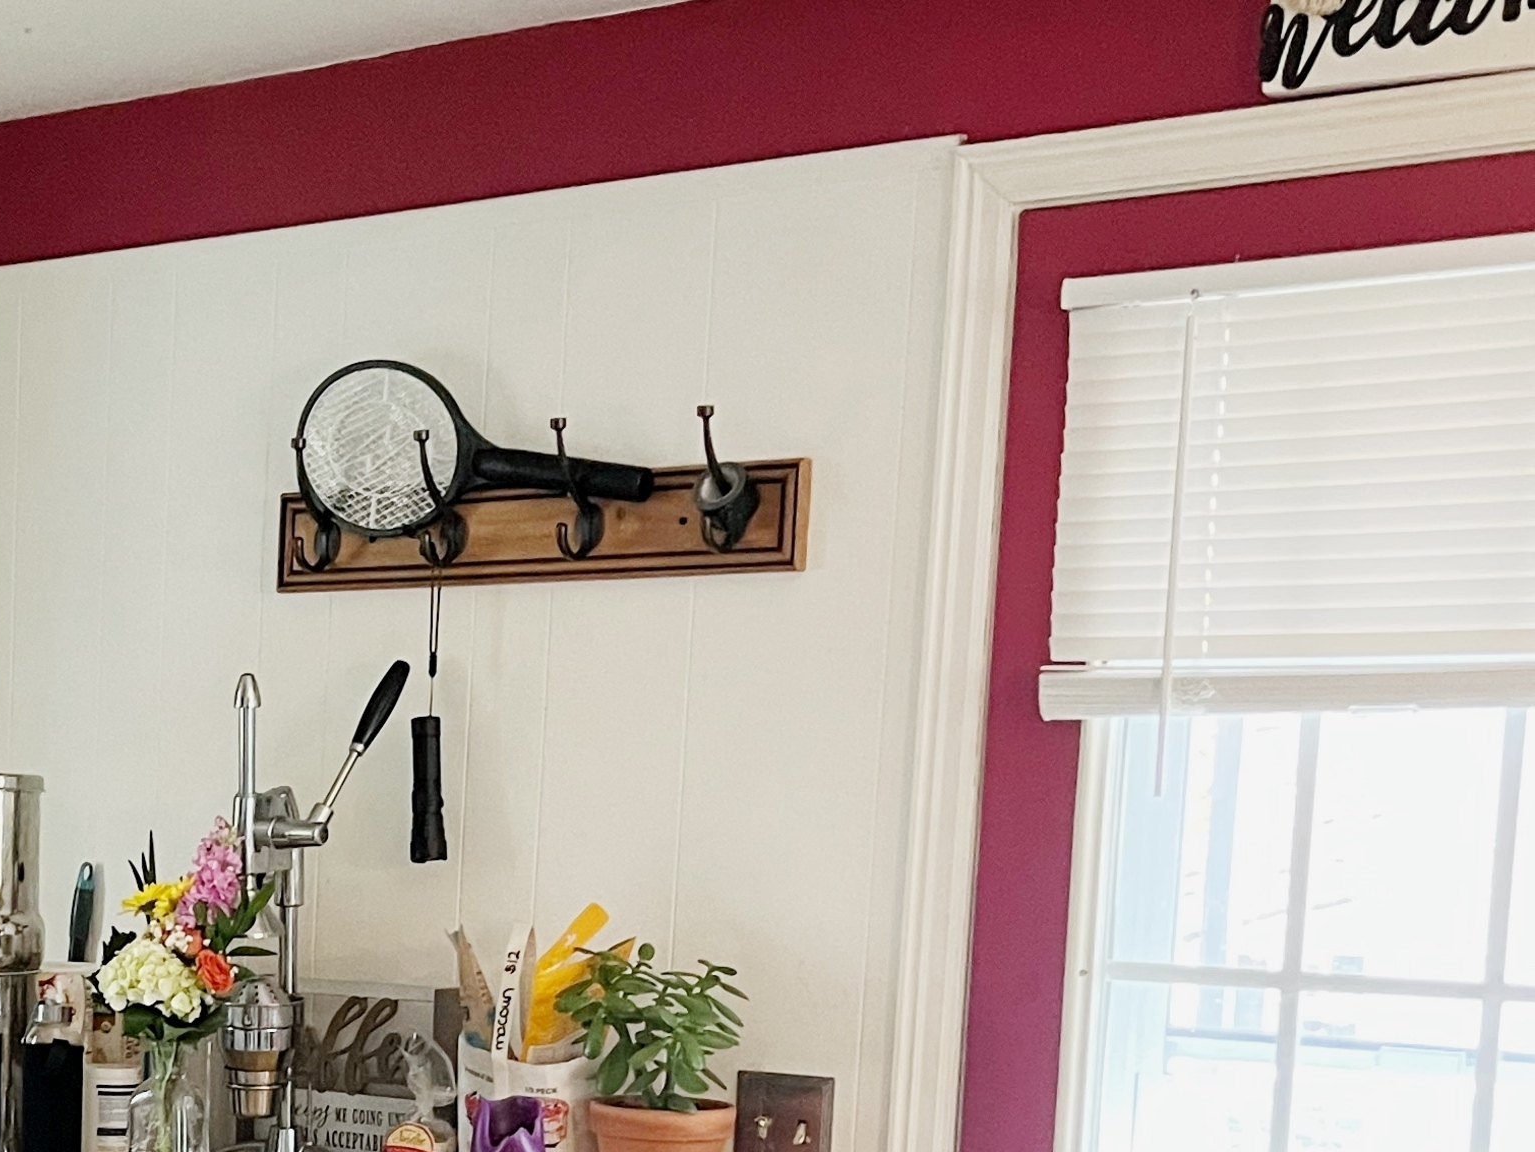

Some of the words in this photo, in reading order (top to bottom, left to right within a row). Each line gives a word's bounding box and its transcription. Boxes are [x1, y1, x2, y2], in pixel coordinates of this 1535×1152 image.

[335, 1107, 347, 1123] ME
[351, 1108, 383, 1127] GOING
[325, 1130, 384, 1152] ACCEPTABL
